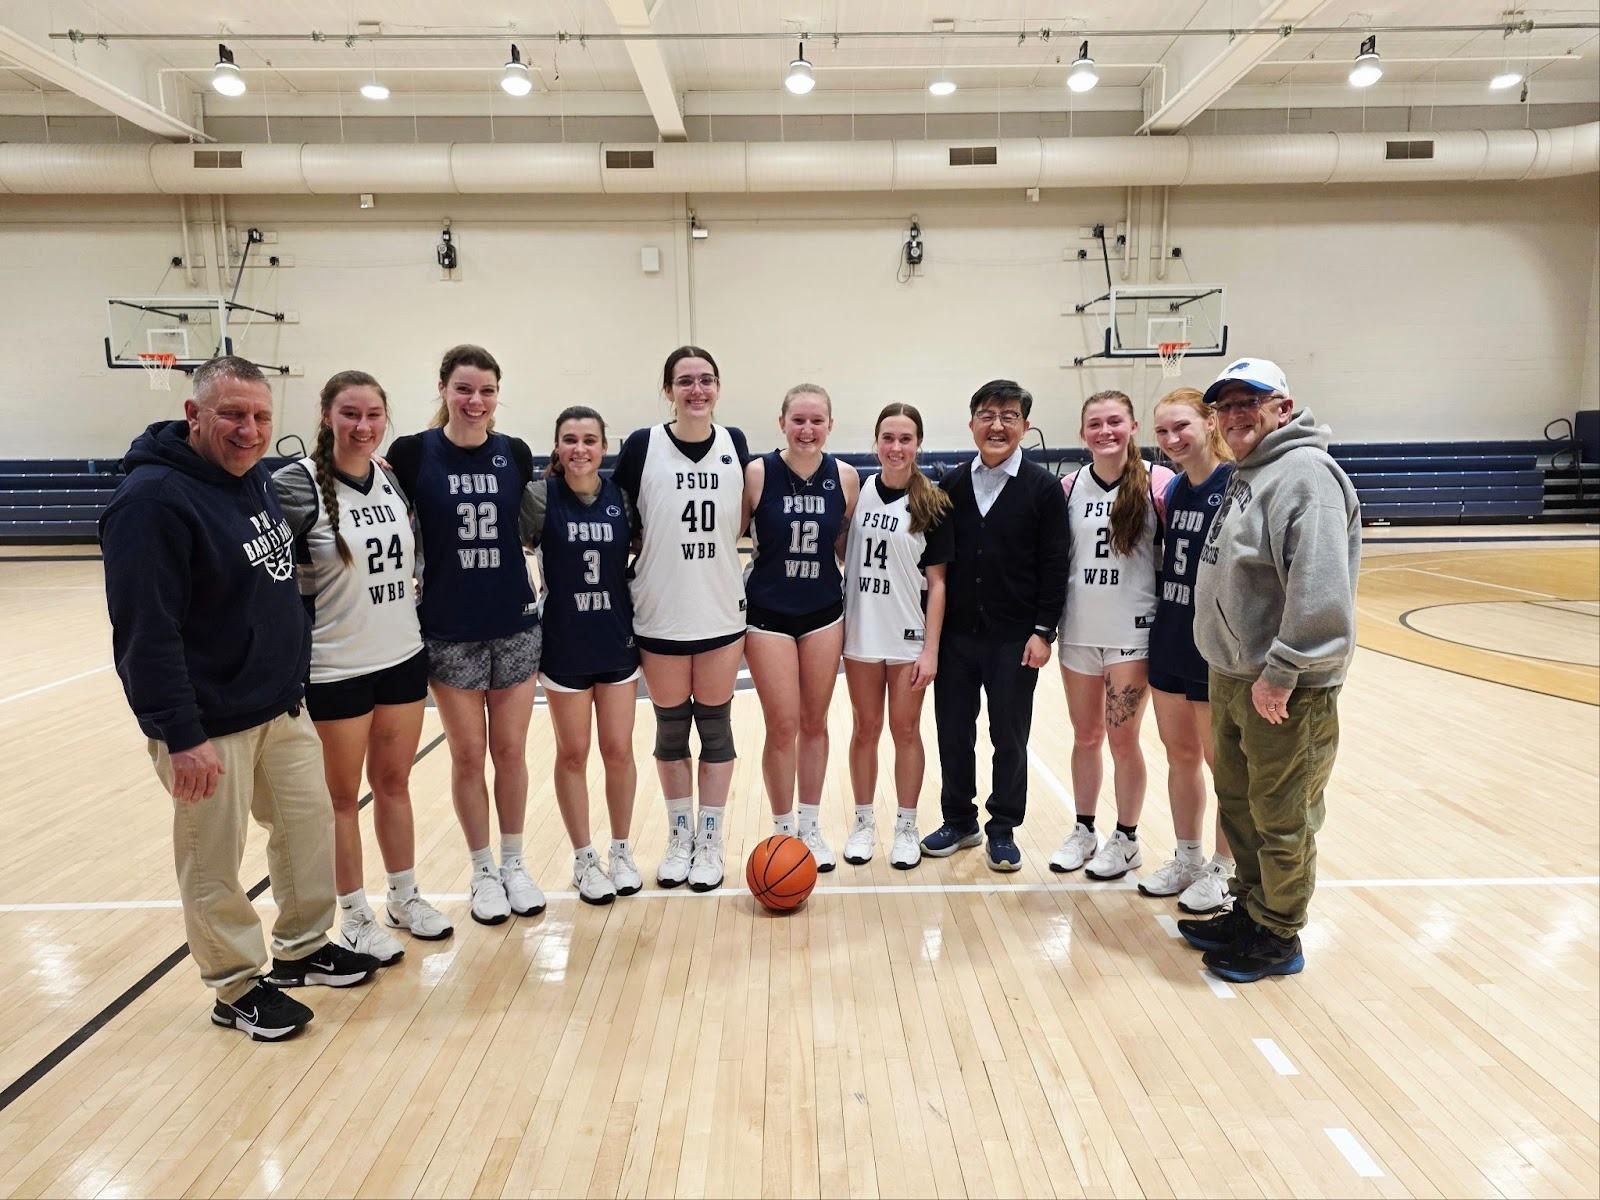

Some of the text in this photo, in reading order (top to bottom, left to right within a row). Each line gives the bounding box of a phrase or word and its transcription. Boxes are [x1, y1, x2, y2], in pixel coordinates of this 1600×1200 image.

[448, 473, 499, 495] PSUD
[676, 472, 719, 490] PSUD
[350, 505, 397, 528] PSUD
[681, 500, 715, 533] 40
[783, 495, 826, 515] PSUD
[1084, 501, 1113, 518] PSU
[456, 501, 499, 541] 32
[567, 522, 614, 542] PSUD
[862, 512, 899, 533] PSUD
[1171, 509, 1205, 533] PSUD
[789, 520, 820, 554] 12
[1096, 527, 1111, 559] 2
[366, 534, 404, 575] 24
[457, 547, 501, 570] WBB
[681, 543, 716, 560] WBB
[864, 537, 888, 570] 14
[1173, 537, 1190, 576] 5
[583, 549, 601, 585] 3
[785, 560, 821, 579] WBB
[1084, 568, 1120, 586] WBB
[369, 581, 405, 605] WBB
[859, 577, 891, 595] WBB
